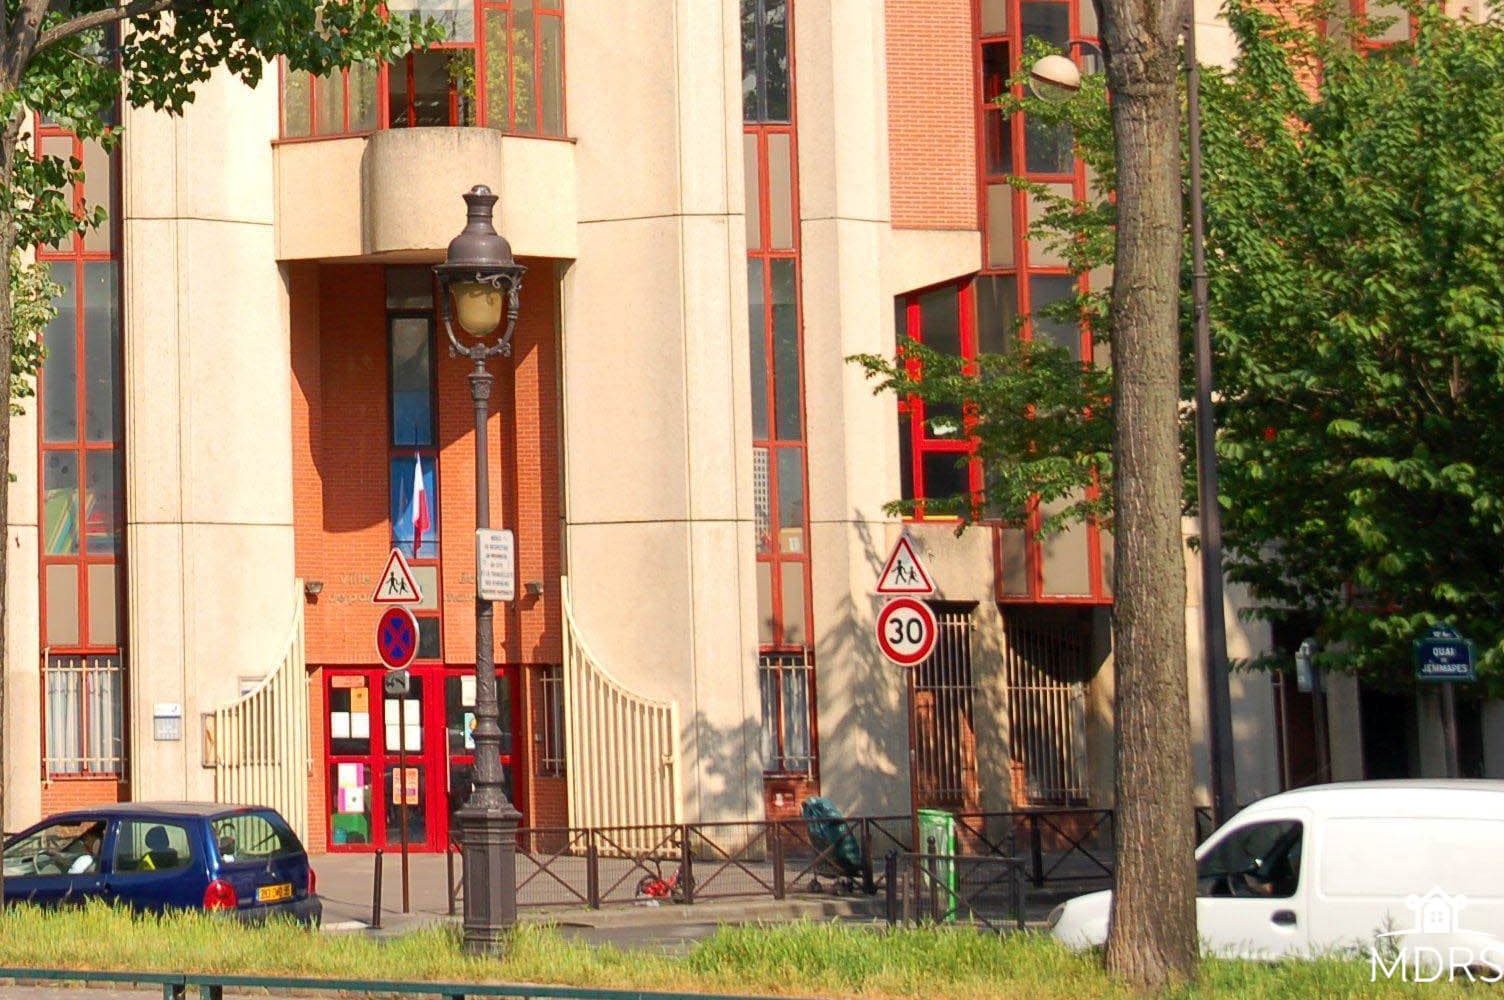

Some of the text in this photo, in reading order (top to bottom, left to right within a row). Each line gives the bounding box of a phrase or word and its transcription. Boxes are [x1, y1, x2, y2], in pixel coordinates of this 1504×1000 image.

[889, 617, 924, 645] 30
[1432, 647, 1456, 657] QUAI
[1422, 663, 1469, 673] JEMMAPES
